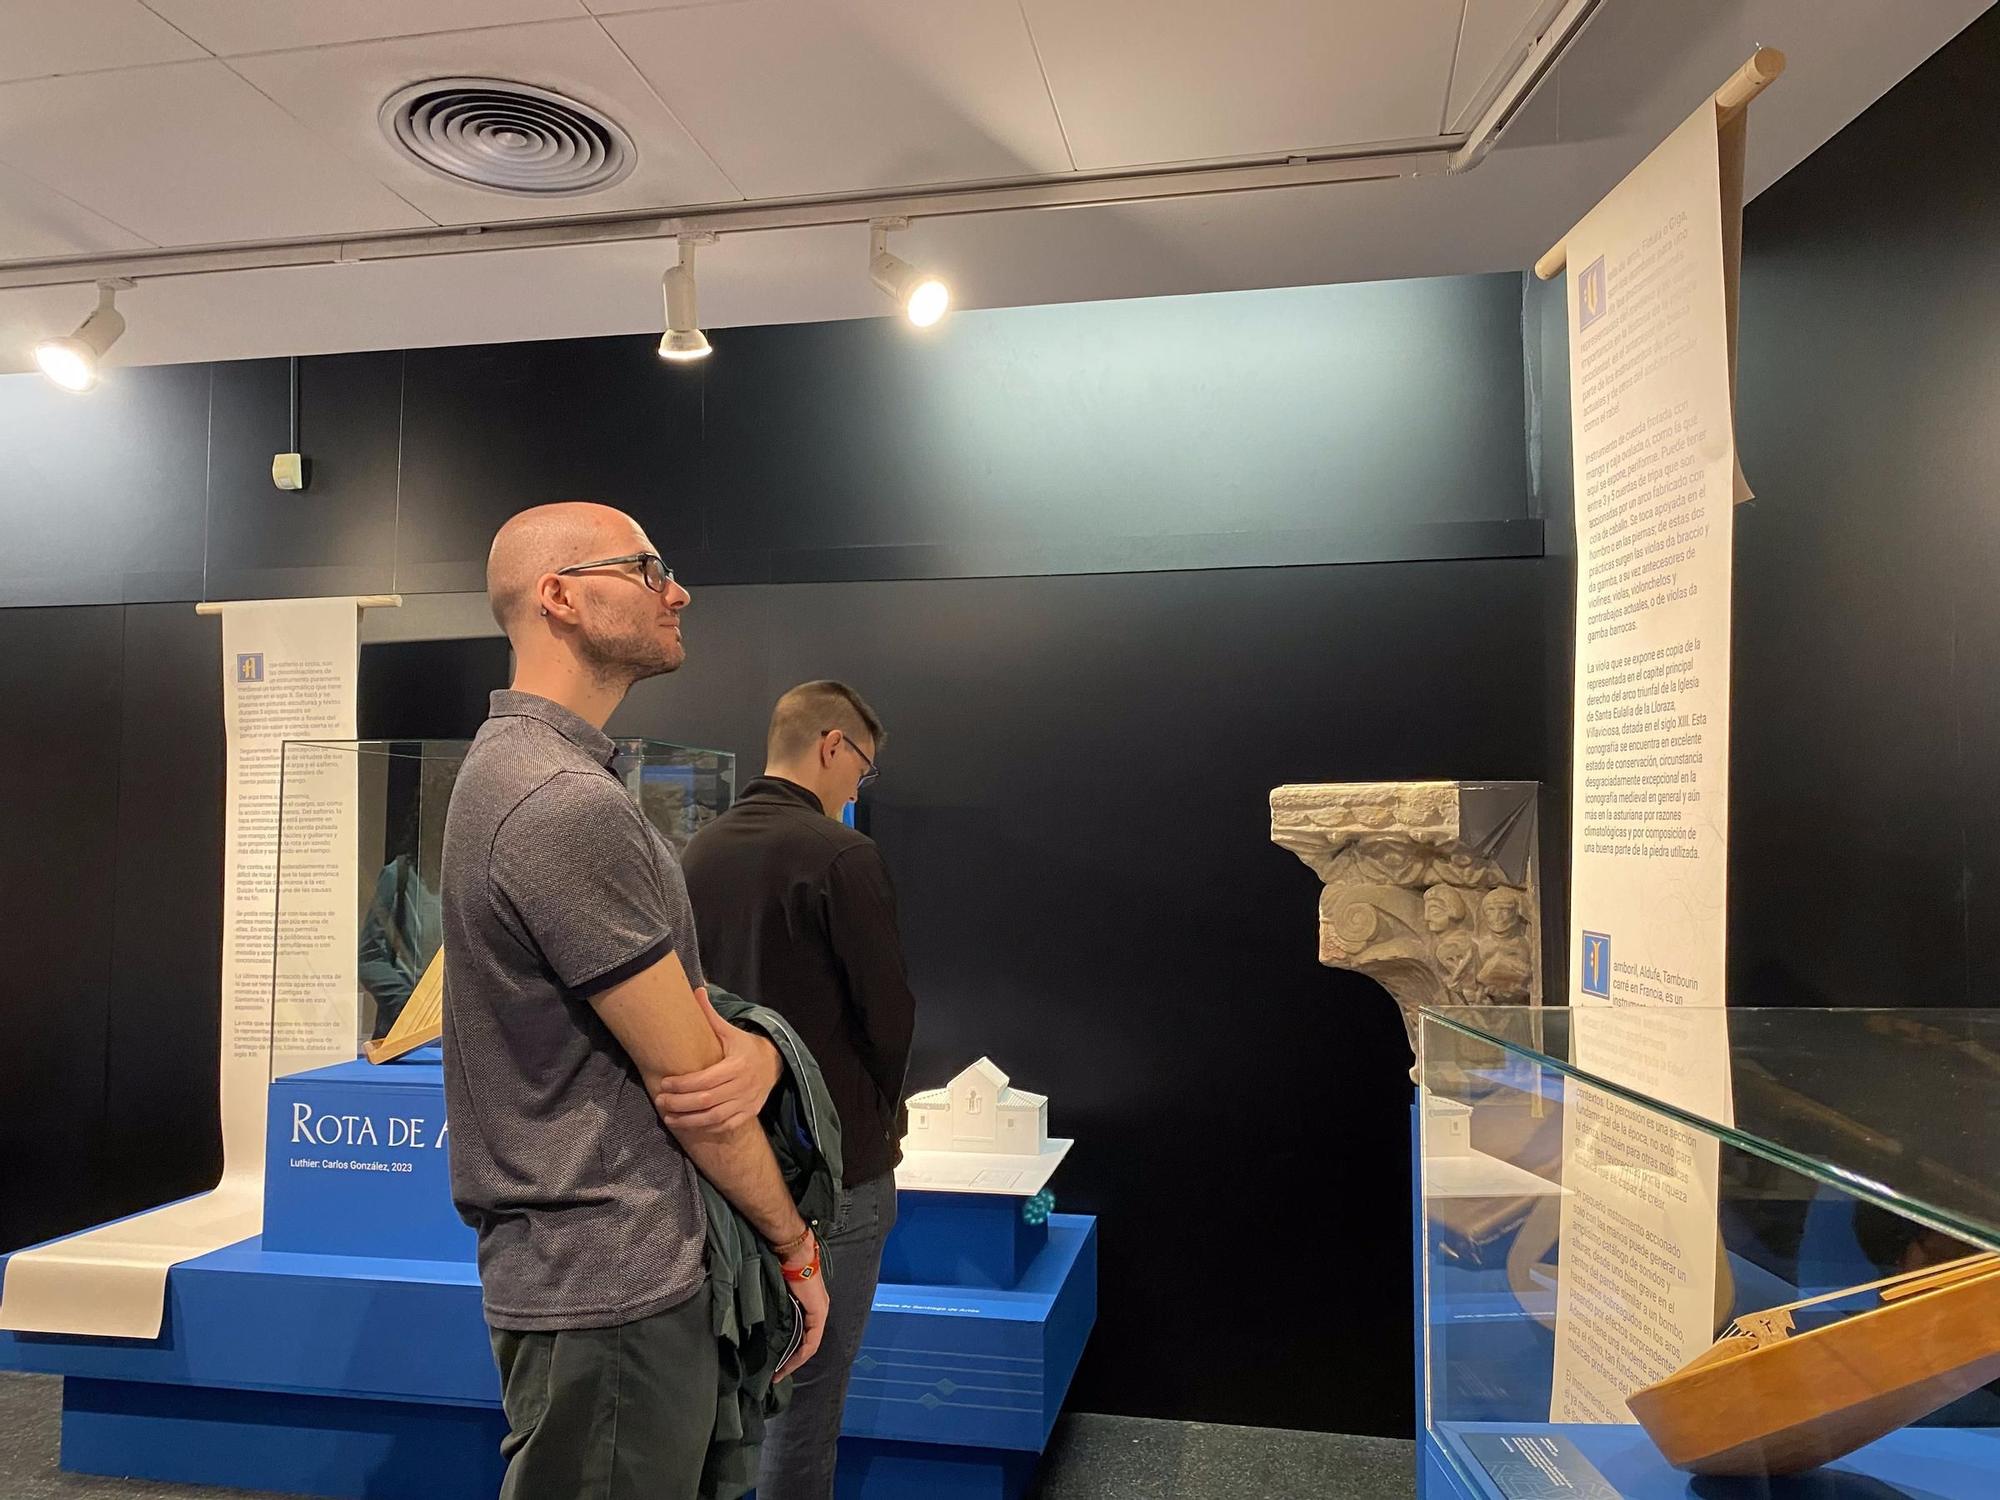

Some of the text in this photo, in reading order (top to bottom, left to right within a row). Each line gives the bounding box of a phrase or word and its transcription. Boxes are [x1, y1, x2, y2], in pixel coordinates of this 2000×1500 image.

[1642, 547, 1695, 574] antecesores de
[1624, 599, 1649, 615] actuales,
[1650, 598, 1655, 607] o
[1656, 594, 1665, 605] de
[1667, 588, 1687, 602] violas
[1689, 584, 1697, 596] da
[1587, 639, 1700, 673] La viola que se expone es copia de la
[1587, 658, 1693, 691] representada en el capitel principal
[1587, 678, 1699, 706] derecho del arco triunfal de la Iglesia
[1587, 712, 1593, 722] de
[1595, 710, 1611, 721] Santa
[1613, 705, 1634, 718] Eulalia
[1635, 704, 1642, 715] de
[1644, 703, 1650, 713] la
[1586, 726, 1620, 738] Villaviciosa,
[1622, 721, 1643, 734] datada
[1645, 723, 1652, 731] en
[1654, 719, 1659, 730] el
[1661, 717, 1676, 732] siglo
[1692, 714, 1707, 726] Esta
[1586, 734, 1701, 756] iconografía se encuentra en excelente
[1586, 753, 1702, 771] estado de conservación, circunstancia
[1585, 771, 1696, 789] desgraciadamente excepcional en la
[1585, 790, 1700, 806] iconografía medieval en general y aún
[1585, 809, 1681, 823] más en la asturiana por razones
[1585, 826, 1696, 841] climatológicas y por composición de
[1584, 843, 1700, 859] una buena parte de la piedra utilizada.
[1613, 980, 1629, 991] carré
[1630, 984, 1638, 993] en
[1640, 984, 1664, 1002] Francia,
[1665, 993, 1673, 1002] es
[1675, 995, 1683, 1005] un
[290, 1158, 413, 1172] Luthier: Carlos González, 2023
